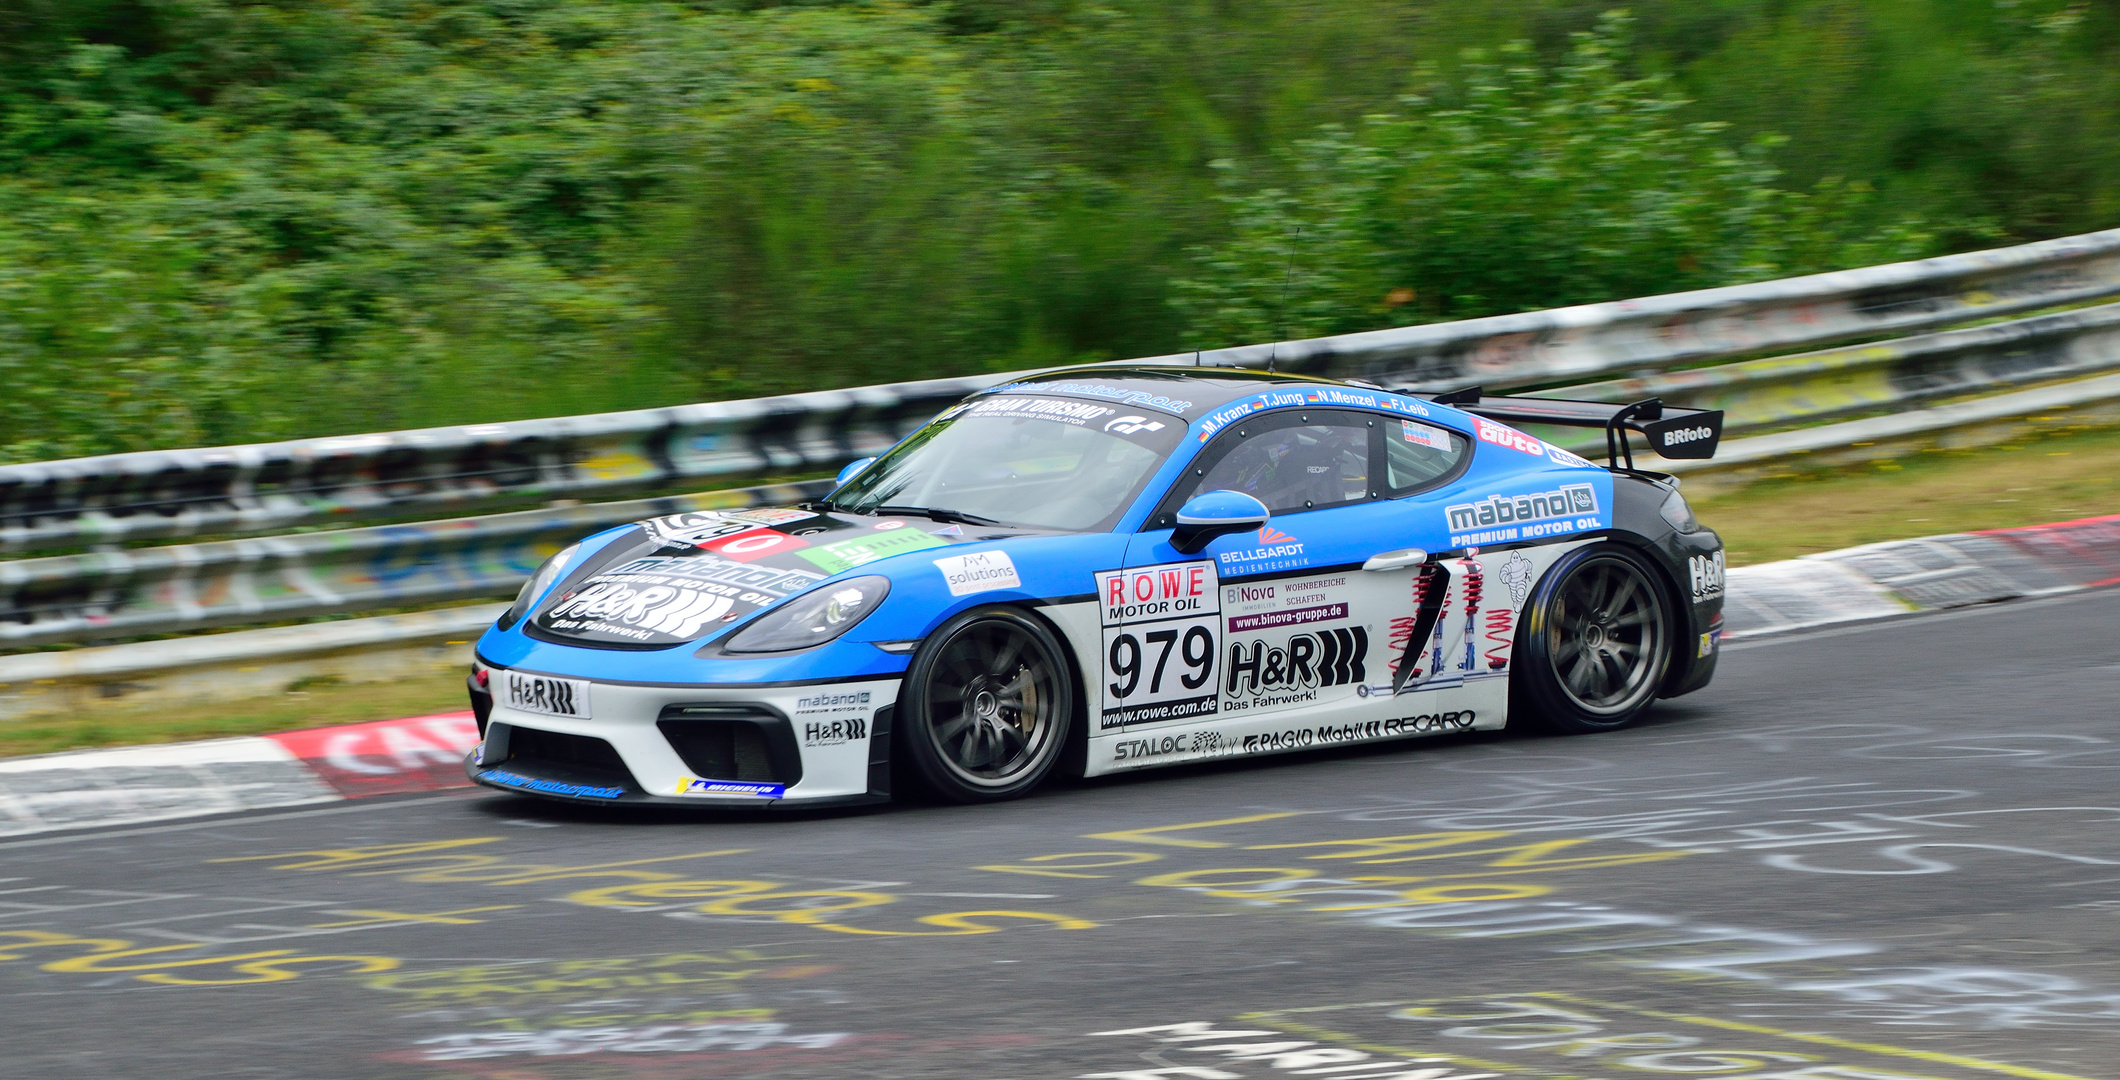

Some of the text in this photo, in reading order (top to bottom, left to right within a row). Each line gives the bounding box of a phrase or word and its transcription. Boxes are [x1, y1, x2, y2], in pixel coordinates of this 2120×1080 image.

[1036, 413, 1085, 425] SIMULATOR
[1201, 390, 1429, 435] M.Kranz T.Jung N.Menzel F.Leib
[1480, 427, 1544, 456] auto
[1664, 426, 1712, 446] BRfoto
[1450, 489, 1574, 529] mabanol
[1452, 517, 1601, 547] PREMIUM MOTOR OIL
[1220, 544, 1304, 563] BELLGARDT
[611, 558, 796, 590] mabanol
[949, 567, 1014, 585] solutions
[1225, 558, 1309, 575] MEDIENTECHNIK
[583, 575, 777, 605] PREMIUM MOTOR OIL
[1228, 578, 1346, 604] BiNova WOHNBEREICHE
[1286, 594, 1326, 606] SCHAFFEN
[1109, 598, 1201, 619] MOTOR OIL
[1236, 604, 1341, 629] www.binova-gruppe.de
[551, 620, 655, 640] Das Fahrwerk!
[1109, 625, 1214, 699] 979
[1227, 633, 1321, 699] H&R
[798, 692, 860, 707] mabanol
[1224, 690, 1317, 711] Das Fahrwerk!
[1102, 697, 1216, 726] www.rowe.com.de
[805, 721, 844, 741] H&R
[1114, 734, 1187, 760] STALOC
[1260, 729, 1313, 748] PAGID
[1317, 723, 1363, 743] Mobil
[1384, 709, 1476, 735] RECARO
[707, 784, 775, 794] MICHELIN
